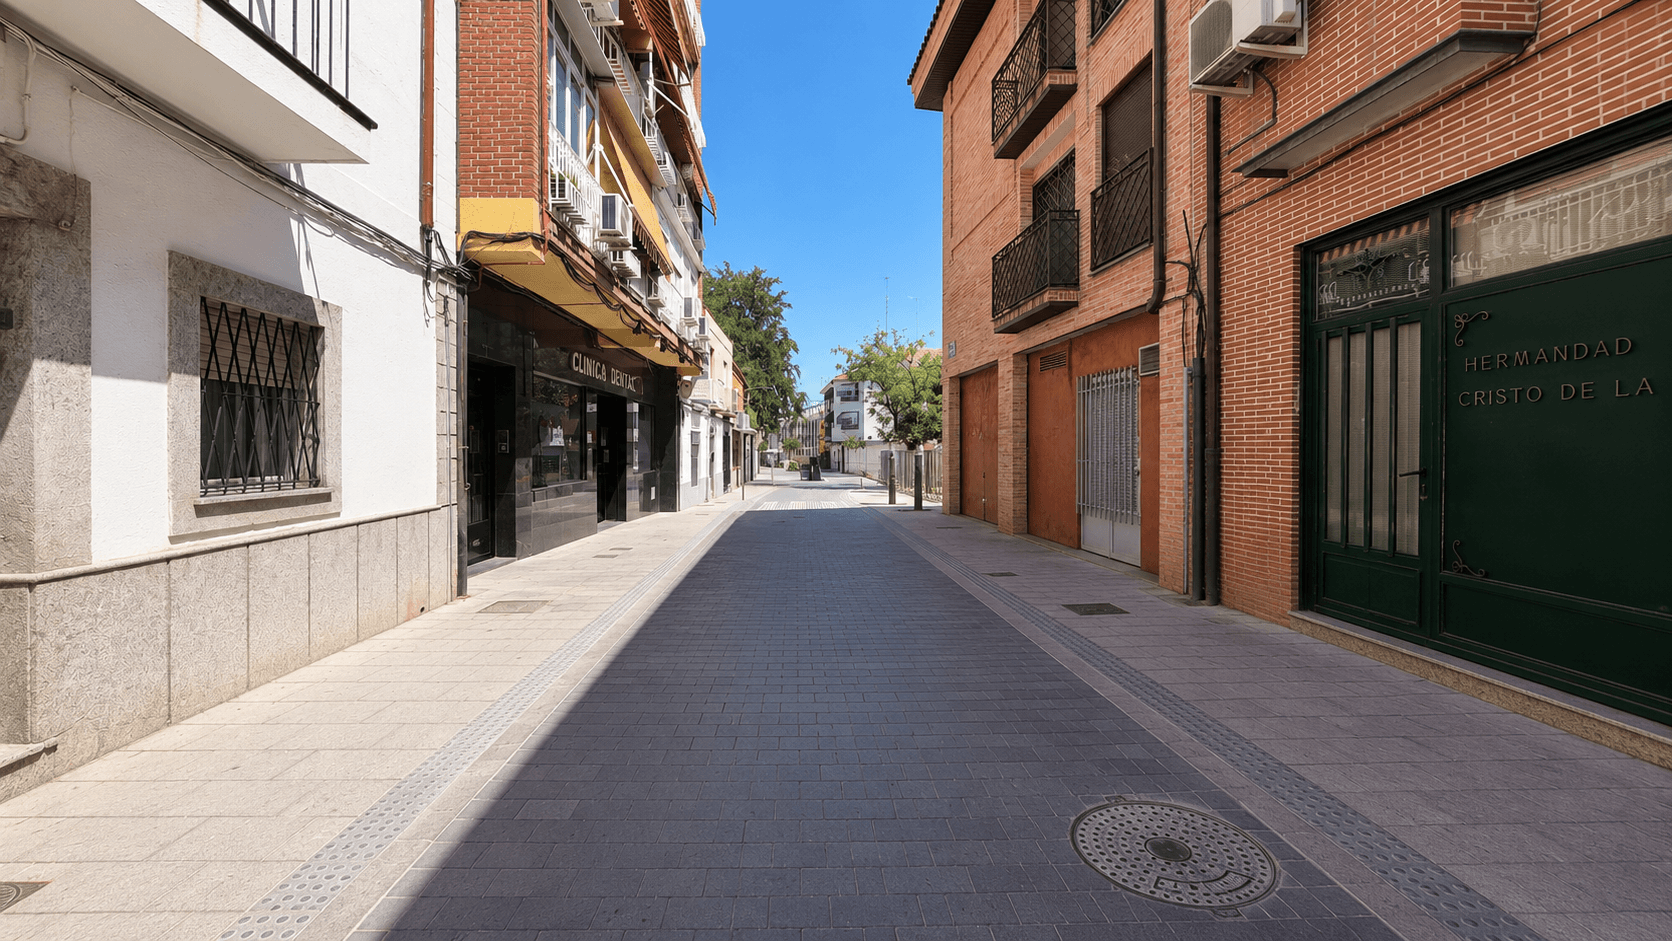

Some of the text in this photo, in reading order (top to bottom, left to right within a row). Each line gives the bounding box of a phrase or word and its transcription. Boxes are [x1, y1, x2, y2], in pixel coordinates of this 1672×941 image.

[1465, 337, 1632, 372] HERMANDAD
[1458, 377, 1654, 407] CRISTO DE LA
